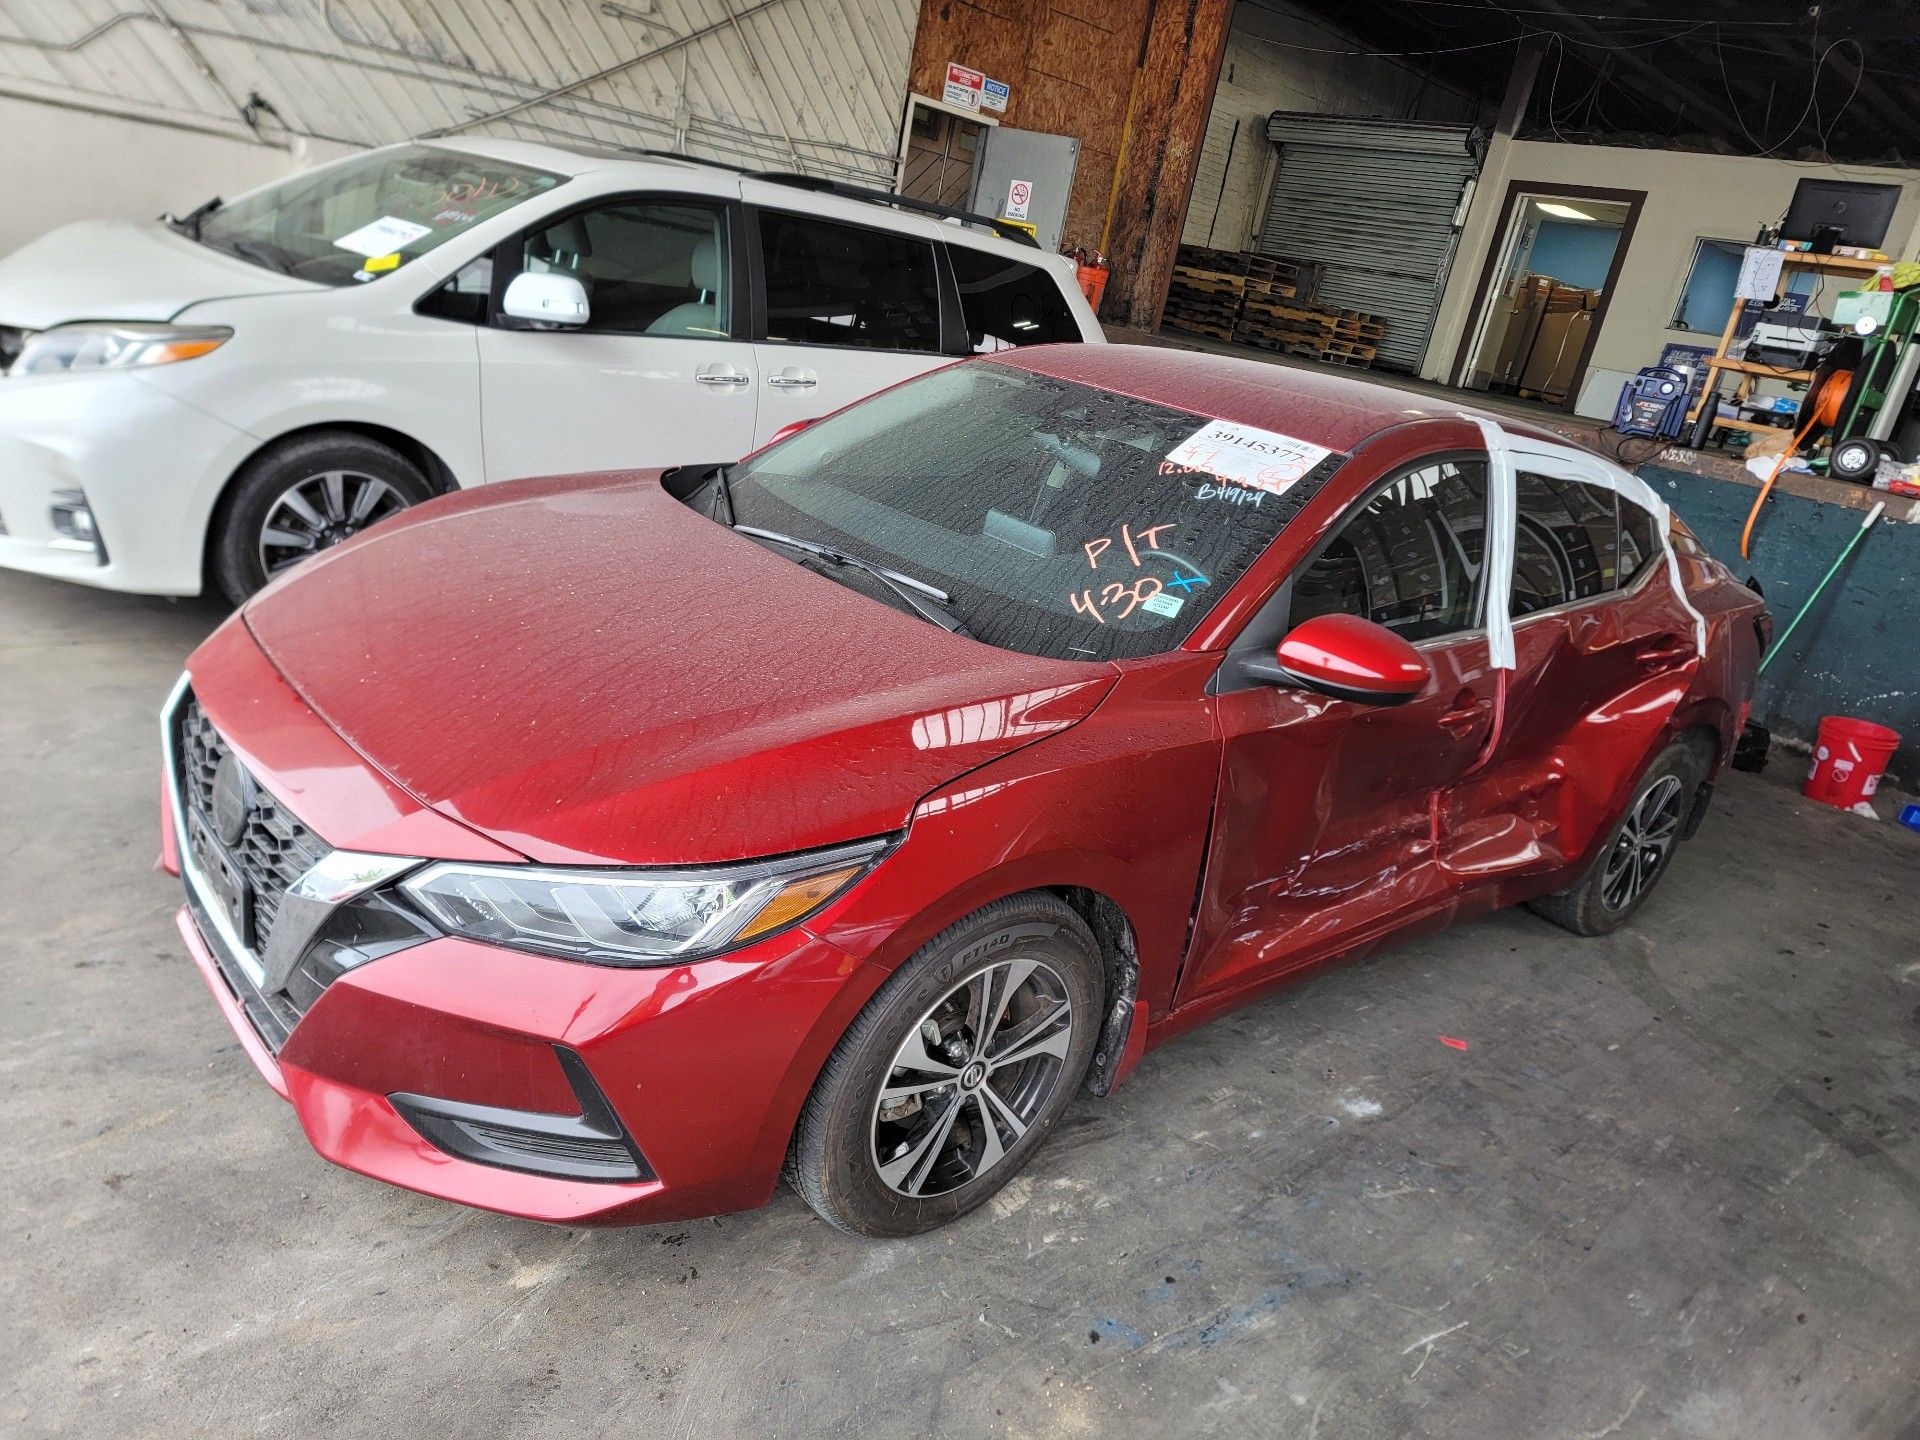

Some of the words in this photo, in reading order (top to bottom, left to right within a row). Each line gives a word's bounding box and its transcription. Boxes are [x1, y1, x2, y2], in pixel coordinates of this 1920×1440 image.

[986, 82, 1006, 95] NOTICE
[1207, 430, 1306, 462] 39145377
[962, 934, 1011, 964] FT140
